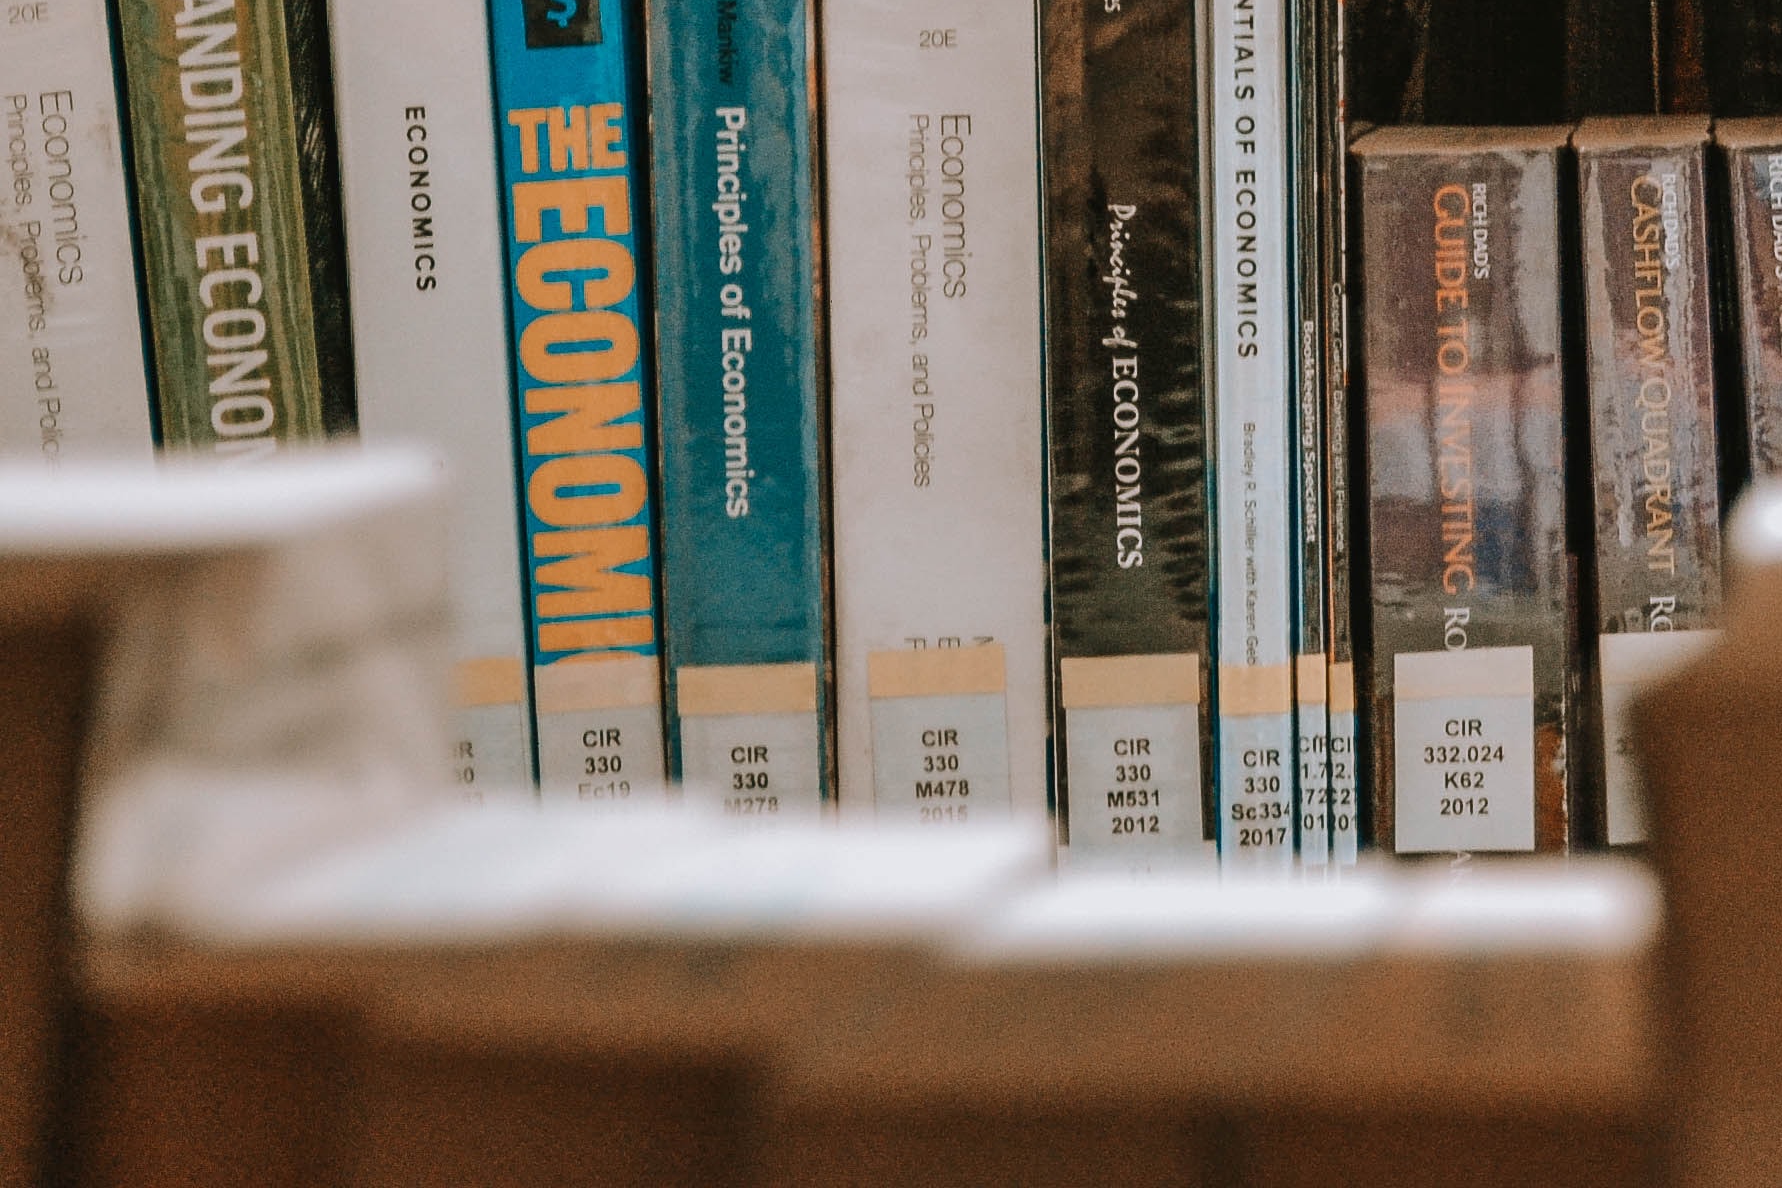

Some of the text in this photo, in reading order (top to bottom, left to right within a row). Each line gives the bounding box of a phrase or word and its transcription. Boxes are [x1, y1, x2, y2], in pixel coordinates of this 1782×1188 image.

[919, 29, 958, 49] 20E
[508, 101, 628, 175] THE
[1235, 115, 1256, 154] OF
[40, 90, 85, 287] Economics
[405, 105, 438, 293] ECONOMICS
[940, 114, 972, 300] Economics
[1471, 182, 1489, 226] RICH
[1433, 182, 1472, 312] GUIDE
[1235, 169, 1259, 359] ECONOMICS
[711, 105, 755, 518] Principles of Economics
[1436, 318, 1470, 375] TO
[911, 352, 934, 396] and
[1630, 173, 1675, 577] CASHFLOW QUADRANT
[1102, 203, 1143, 570] Principles of ECONOMICS
[511, 174, 656, 666] ECONOMI
[1302, 320, 1317, 543] Bookkeeping Specialist
[912, 403, 936, 488] Policies
[1334, 489, 1347, 553] Finance
[1445, 718, 1482, 737] CIR
[582, 728, 622, 748] CIR
[921, 728, 959, 748] CIR
[1113, 737, 1151, 757] CIR
[730, 745, 769, 764] CIR
[923, 755, 959, 773] 330
[1242, 748, 1281, 767] CIR
[1423, 745, 1504, 765] 332.024
[584, 755, 623, 775] 330
[1115, 764, 1152, 783] 330
[732, 771, 769, 790] 330
[915, 779, 970, 799] M478
[1244, 775, 1281, 794] 330
[1444, 771, 1485, 790] K62
[1106, 789, 1160, 808] M531
[1440, 797, 1489, 816] 2012
[1111, 815, 1160, 834] 2012
[1239, 827, 1287, 847] 2017
